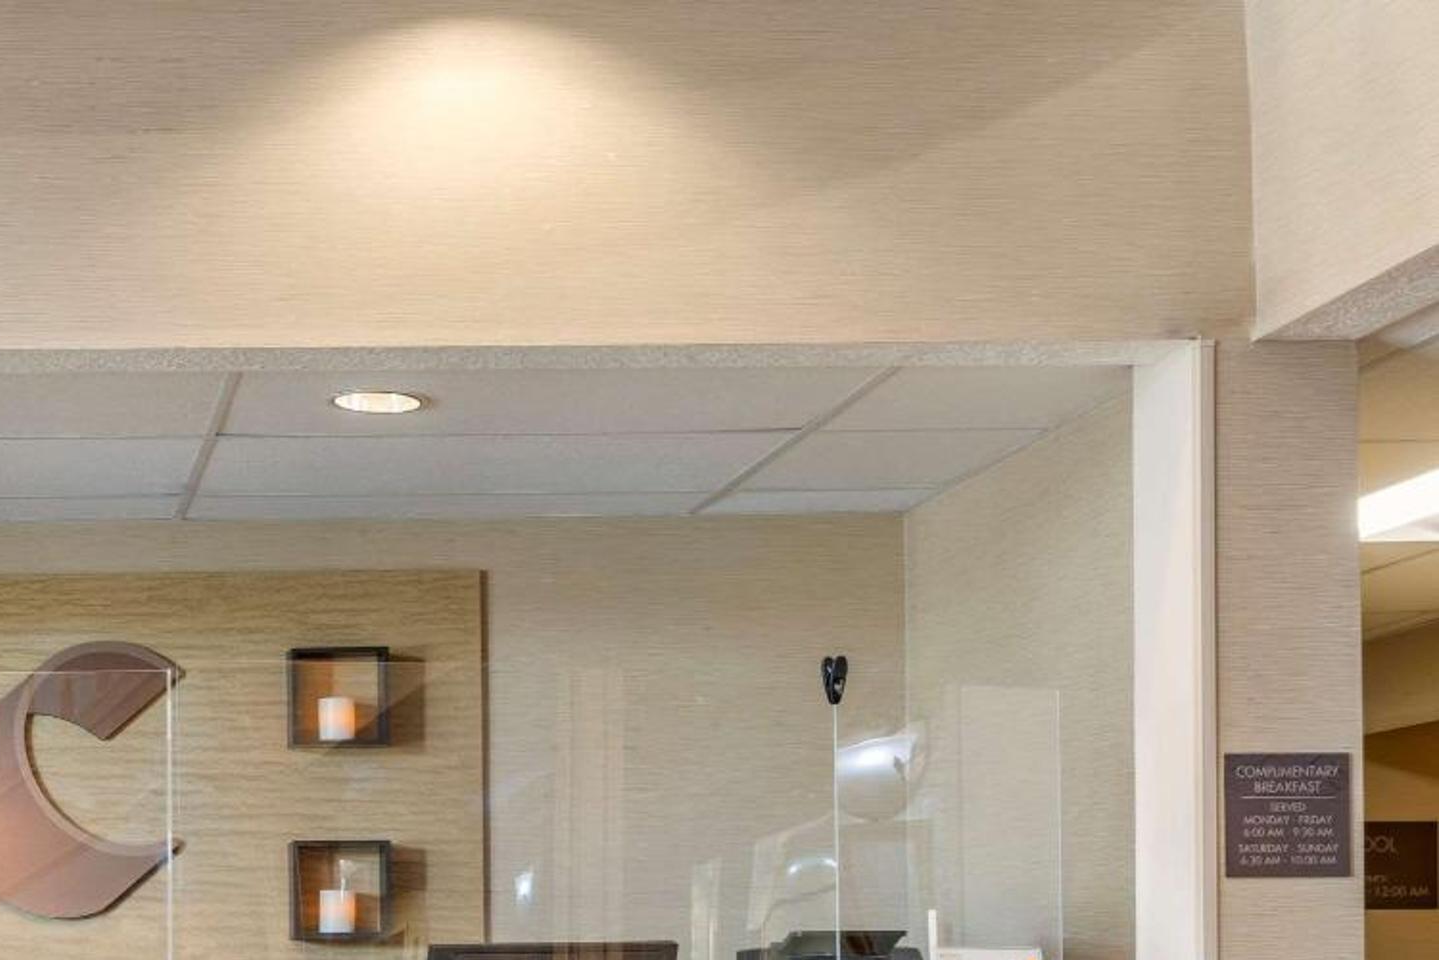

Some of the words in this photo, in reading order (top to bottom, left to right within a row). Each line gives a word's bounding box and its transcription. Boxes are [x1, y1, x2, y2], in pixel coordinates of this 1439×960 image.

[1235, 764, 1339, 778] COMPLIMENTARY
[1254, 780, 1322, 794] BREAKFAST
[1243, 814, 1290, 825] MONDAY
[1298, 814, 1333, 825] FRIDAY
[1267, 827, 1284, 838] AM
[1317, 827, 1334, 838] AM
[1238, 843, 1289, 854] SATURDAY
[1297, 843, 1339, 854] SUNDAY
[1263, 855, 1281, 866] AM
[1320, 855, 1339, 865] AM
[1409, 885, 1431, 898] AM
